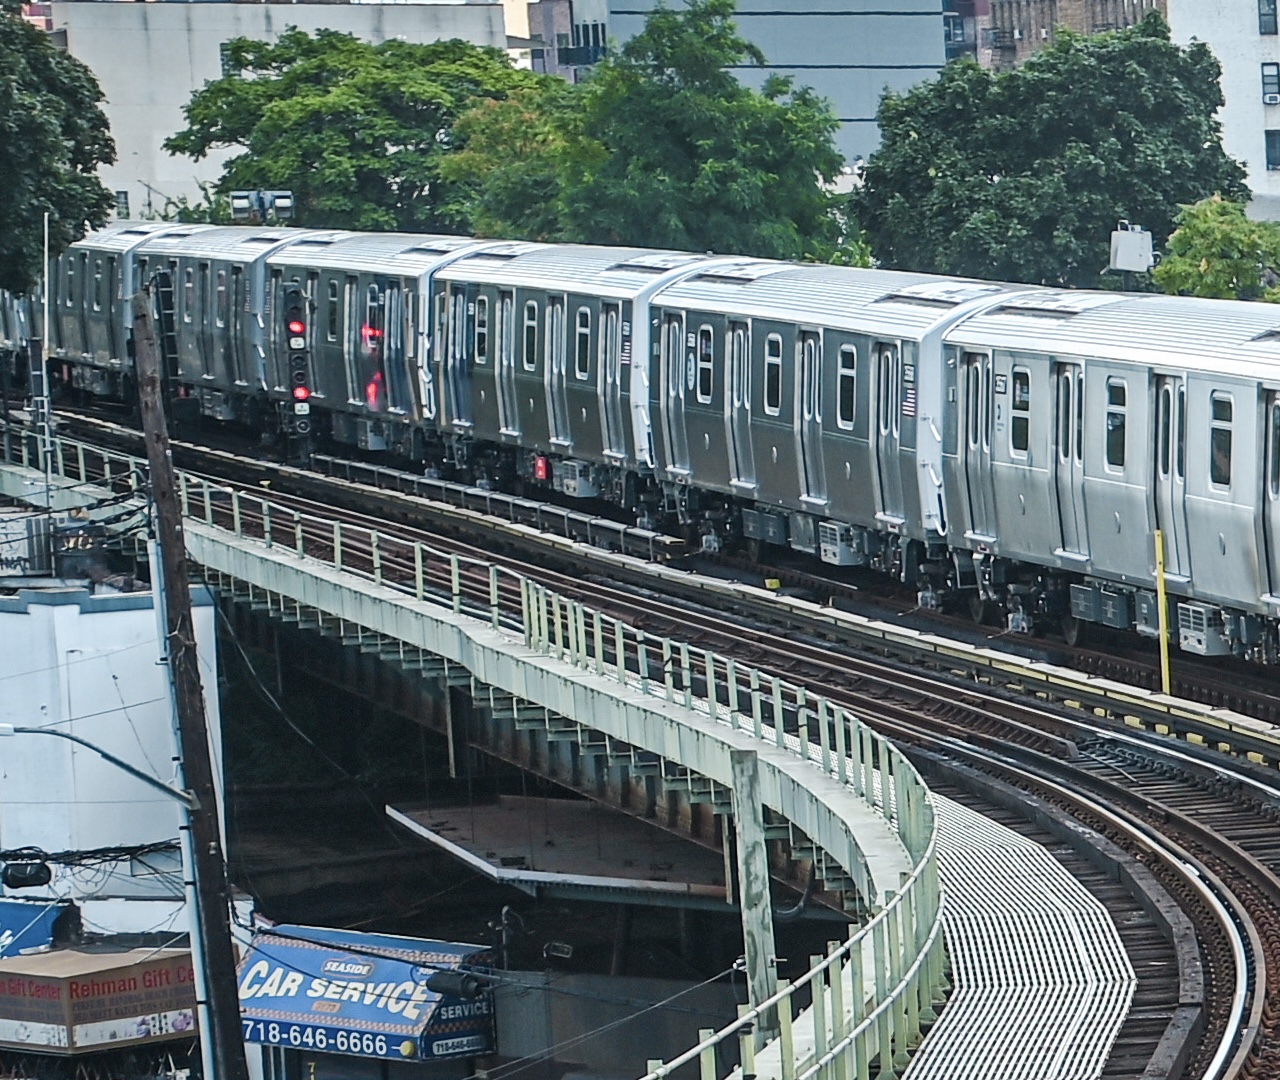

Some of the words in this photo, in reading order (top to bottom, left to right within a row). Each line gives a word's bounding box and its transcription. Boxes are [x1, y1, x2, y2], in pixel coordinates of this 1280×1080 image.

[69, 977, 137, 999] Rehman
[143, 968, 171, 989] Gift
[324, 961, 371, 975] SEASIDE
[238, 960, 304, 1000] CAR
[306, 978, 428, 1020] SERVICE
[441, 1001, 489, 1020] SERVICE
[242, 1020, 387, 1055] 718-646-6666
